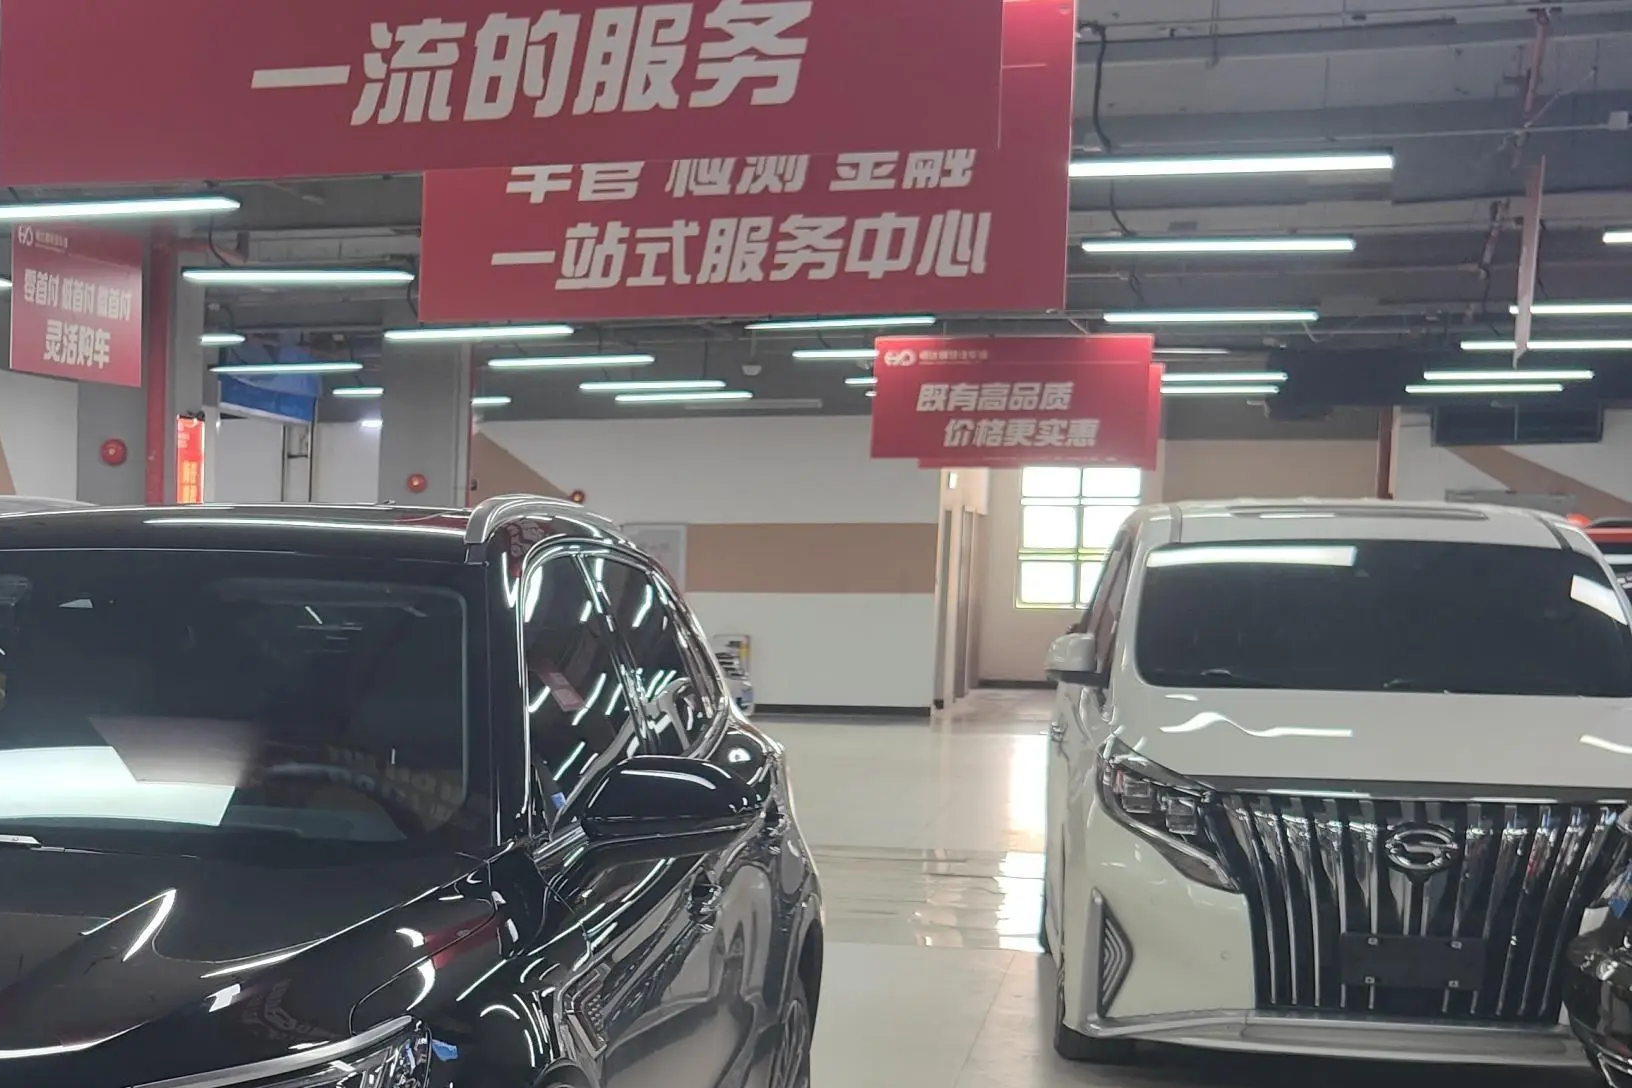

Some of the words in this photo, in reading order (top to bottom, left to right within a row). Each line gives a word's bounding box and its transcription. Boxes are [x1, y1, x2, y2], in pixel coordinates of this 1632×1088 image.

[250, 0, 813, 126] 一流的服务
[490, 209, 992, 291] 一站式服务中心
[43, 320, 111, 369] 灵活购车
[916, 381, 1074, 412] 既有高品质
[943, 418, 1100, 447] 价格更实惠
